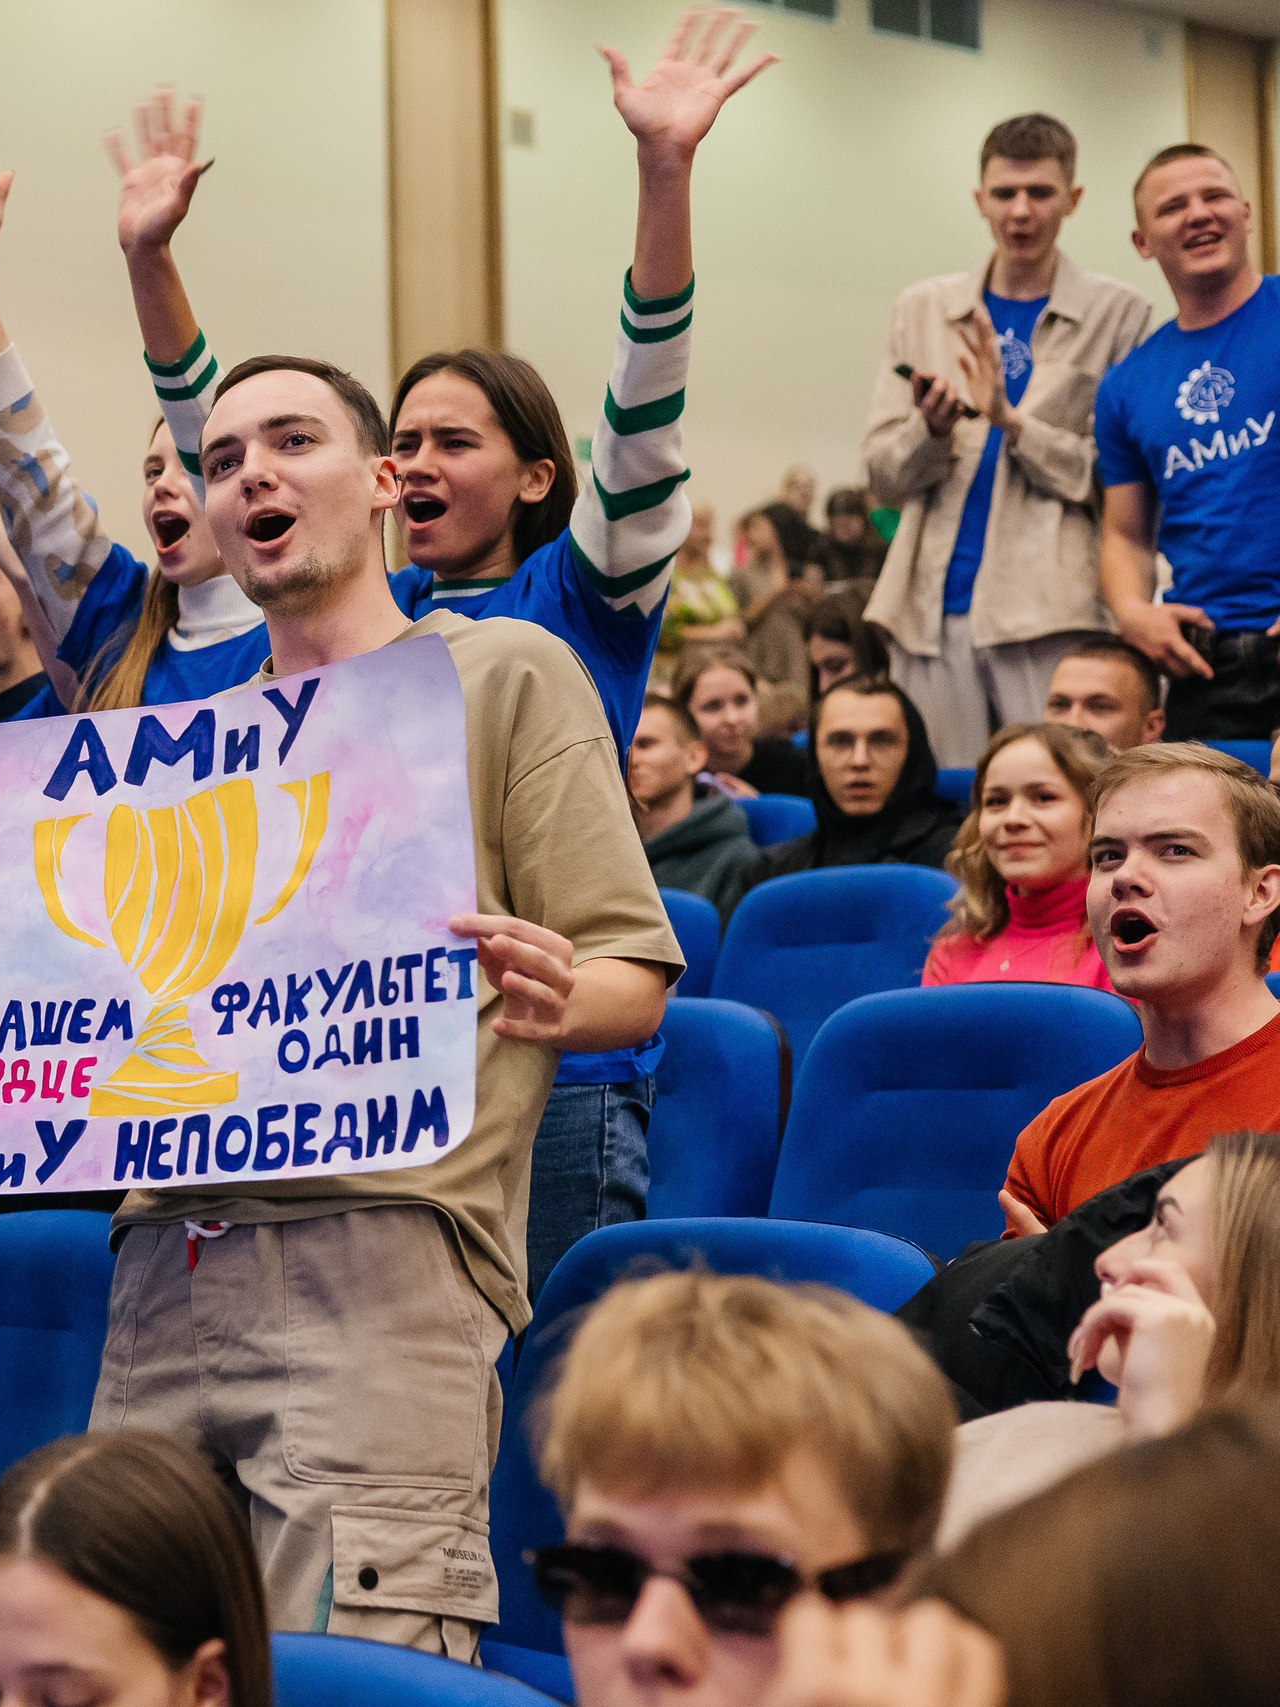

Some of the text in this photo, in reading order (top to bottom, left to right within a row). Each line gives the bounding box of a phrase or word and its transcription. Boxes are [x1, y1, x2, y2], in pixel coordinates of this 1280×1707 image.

[1163, 410, 1276, 480] АМиУ
[42, 677, 321, 802] АМиУ
[211, 946, 479, 1036] ФАКУЛЬТЕТ
[277, 1015, 420, 1074] ОДИН
[113, 1085, 450, 1182] НЕПОБЕДИМ
